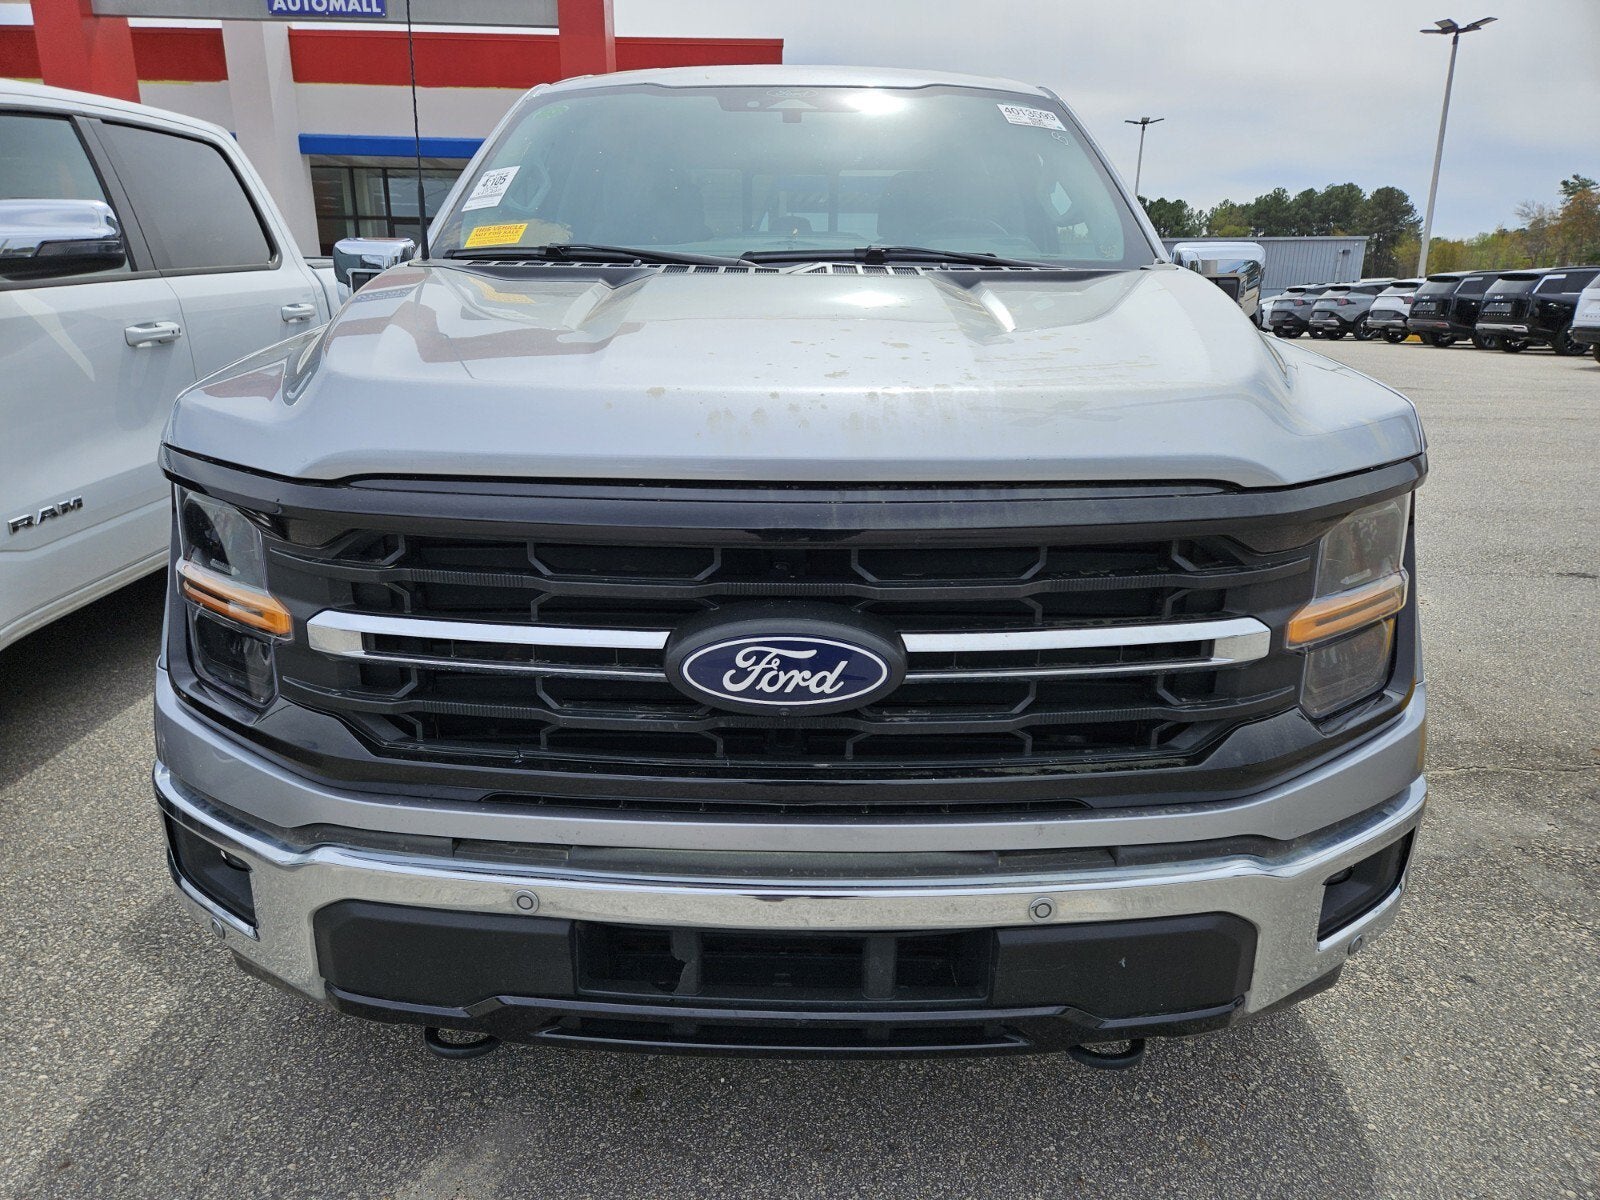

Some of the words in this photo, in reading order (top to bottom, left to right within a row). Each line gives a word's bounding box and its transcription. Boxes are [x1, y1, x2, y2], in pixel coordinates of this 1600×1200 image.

[272, 0, 382, 13] AUTOMALL
[1005, 107, 1055, 121] 4013599
[7, 494, 83, 535] RAM
[722, 646, 849, 694] Ford
